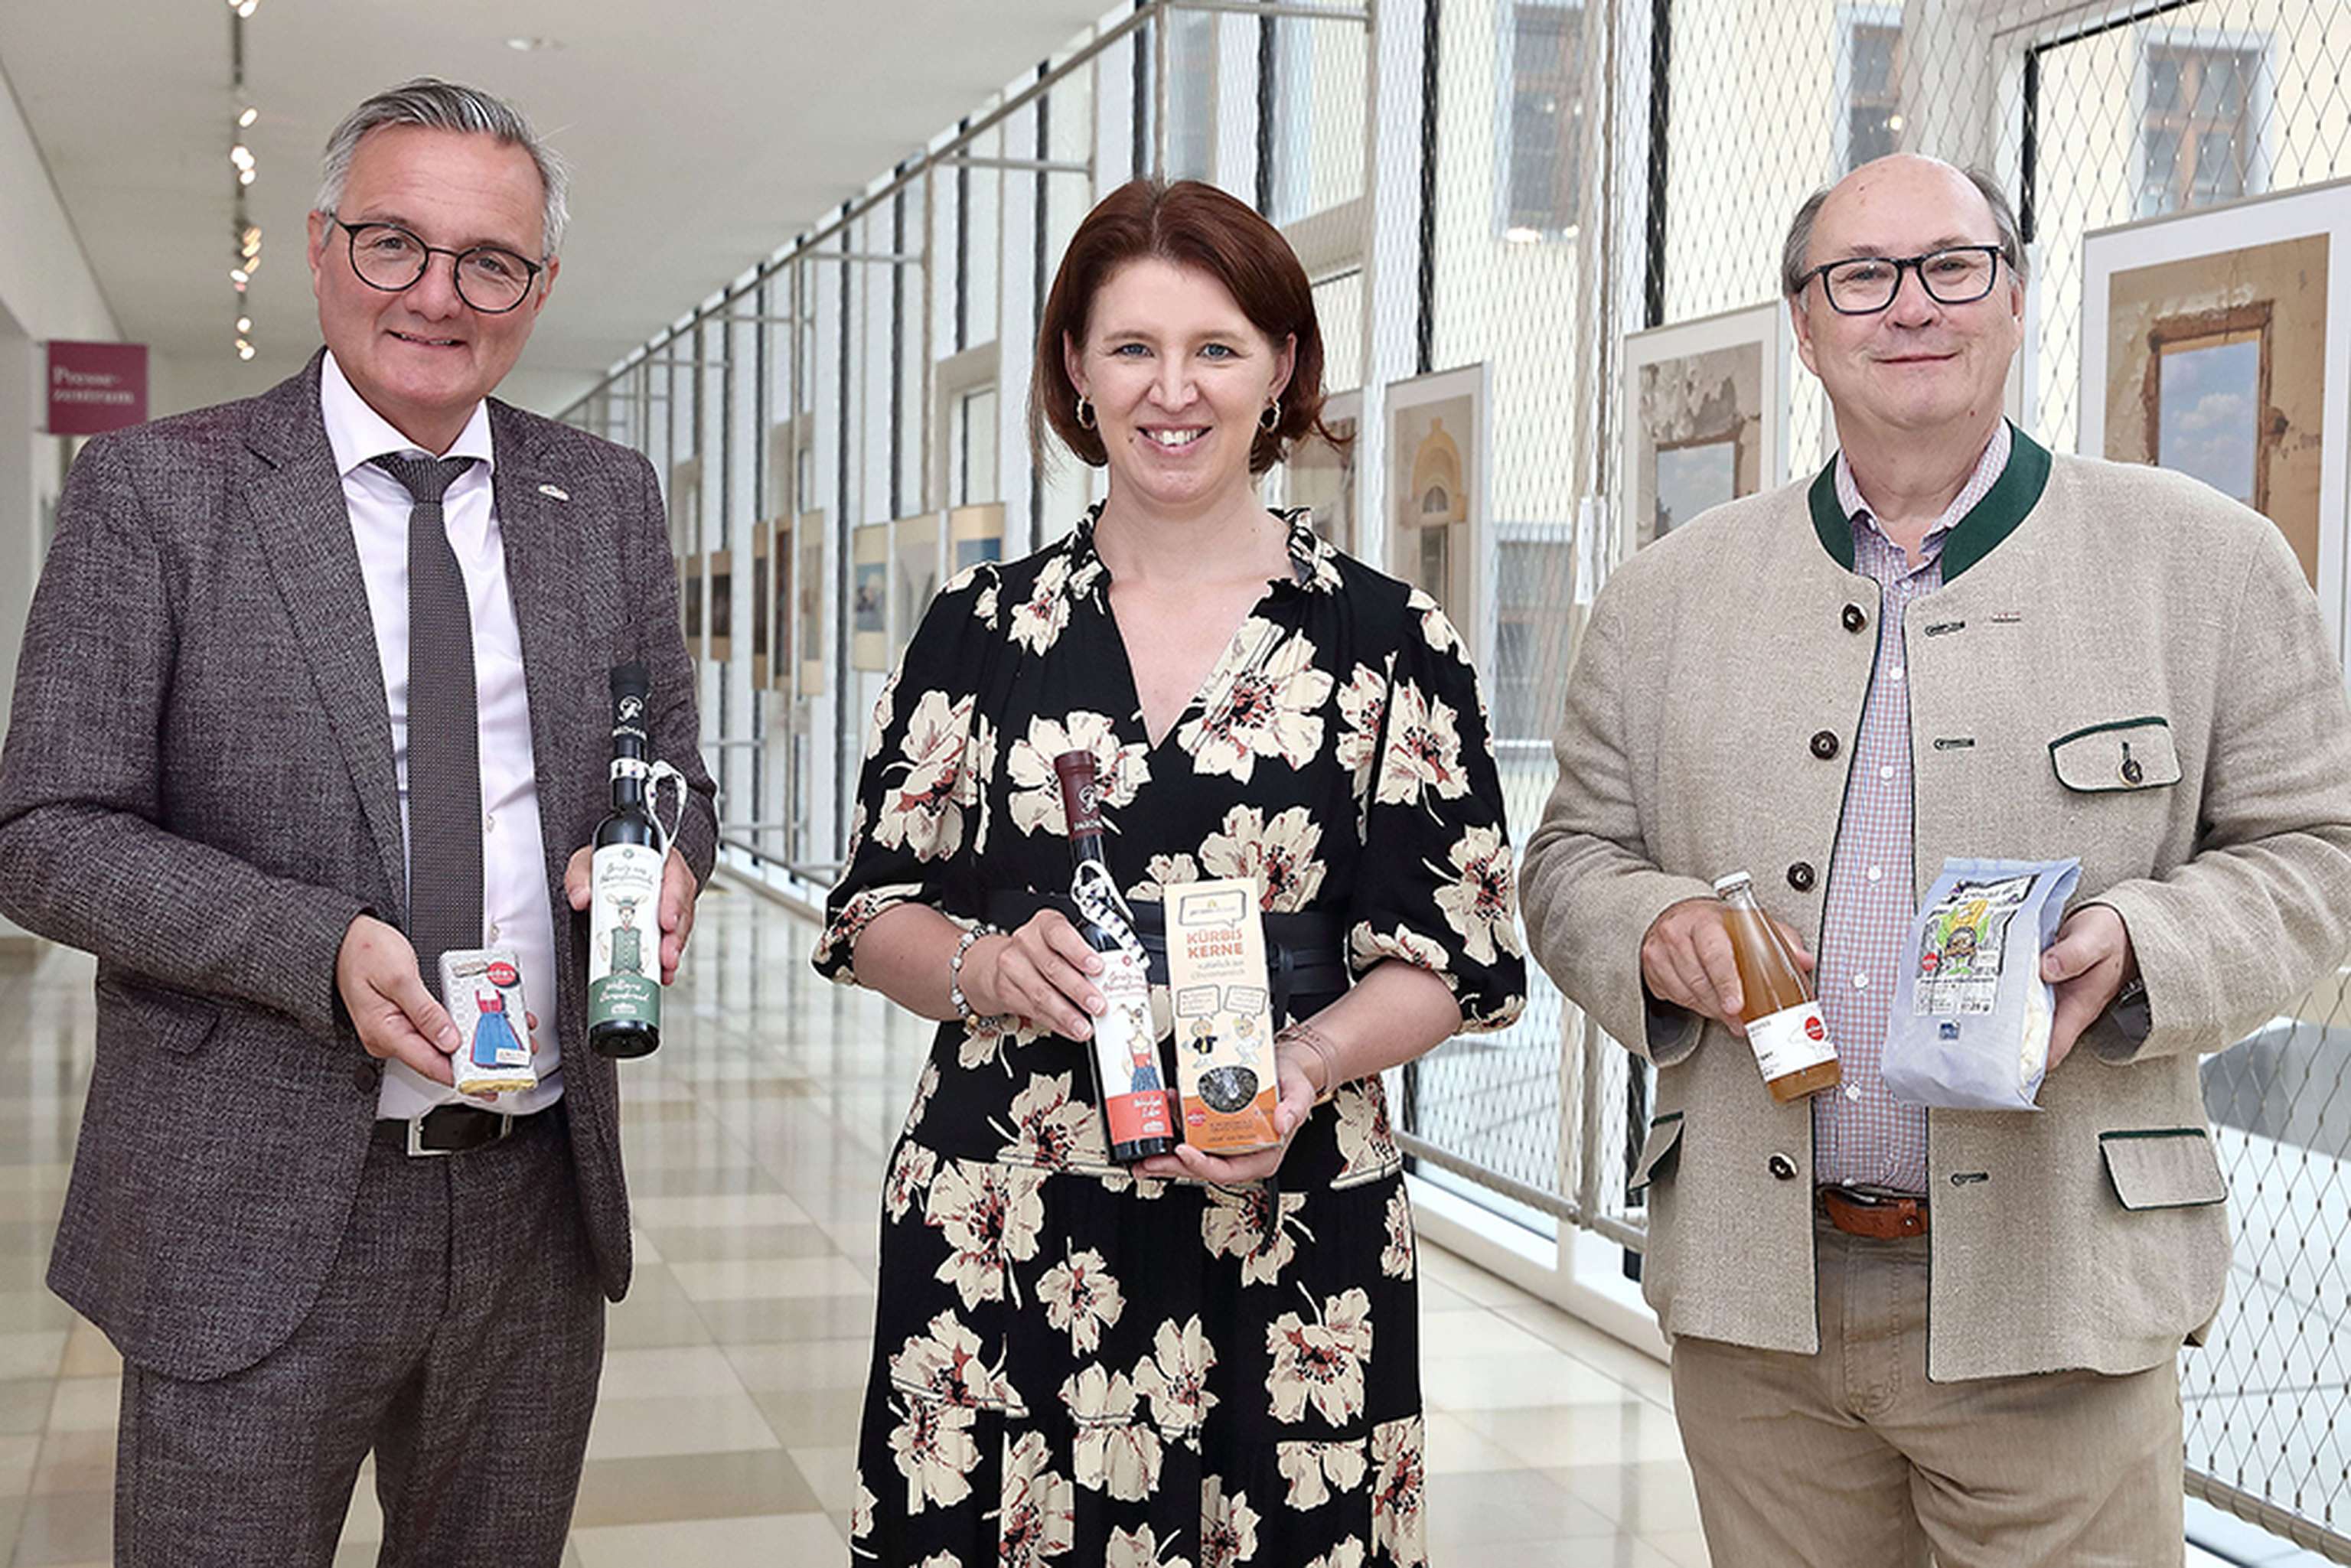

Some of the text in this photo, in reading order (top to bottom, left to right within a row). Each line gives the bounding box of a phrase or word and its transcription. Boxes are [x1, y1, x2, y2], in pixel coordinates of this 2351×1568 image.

[53, 389, 134, 405] zentrum
[1186, 928, 1243, 944] KÜRBIS
[1188, 942, 1244, 959] KERNE
